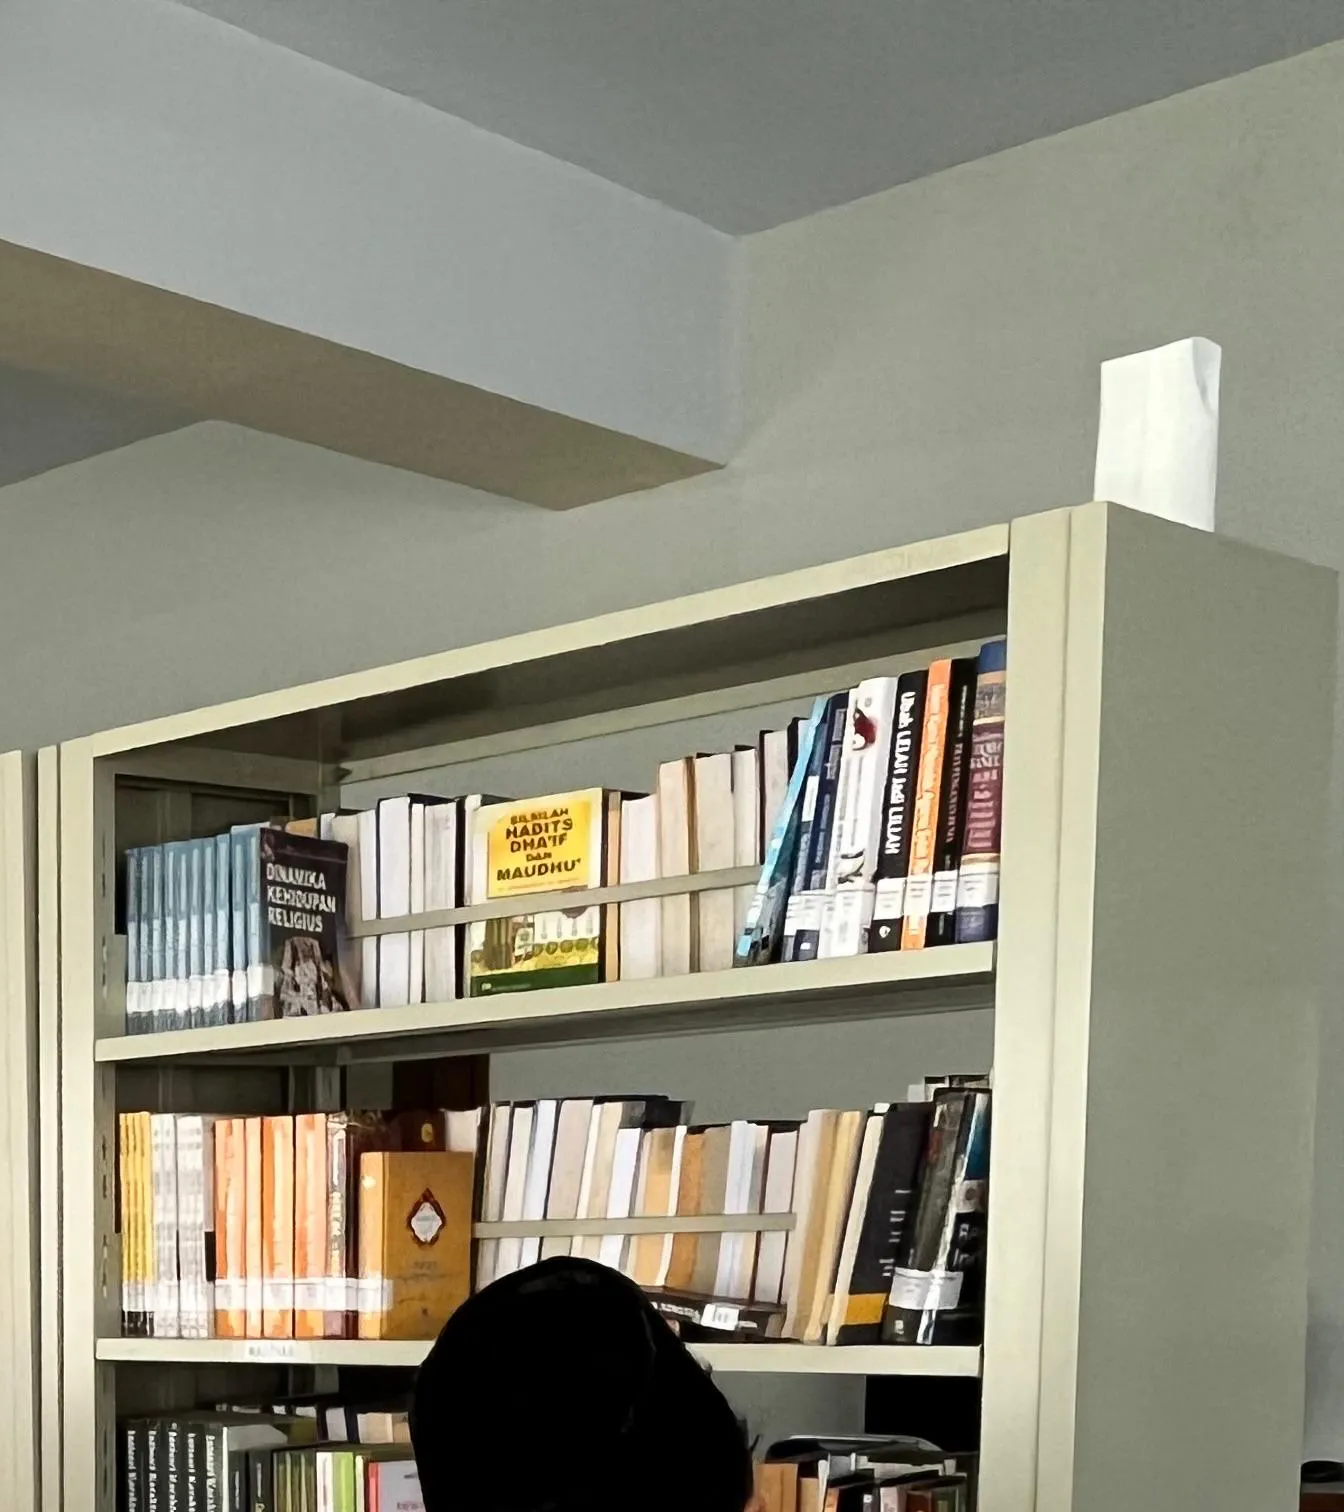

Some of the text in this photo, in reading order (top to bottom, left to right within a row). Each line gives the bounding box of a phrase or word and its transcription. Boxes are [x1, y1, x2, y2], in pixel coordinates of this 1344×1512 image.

[505, 818, 573, 839] HADITS
[267, 885, 336, 913] KEHIDUPAN
[268, 906, 323, 933] RELIGIUS
